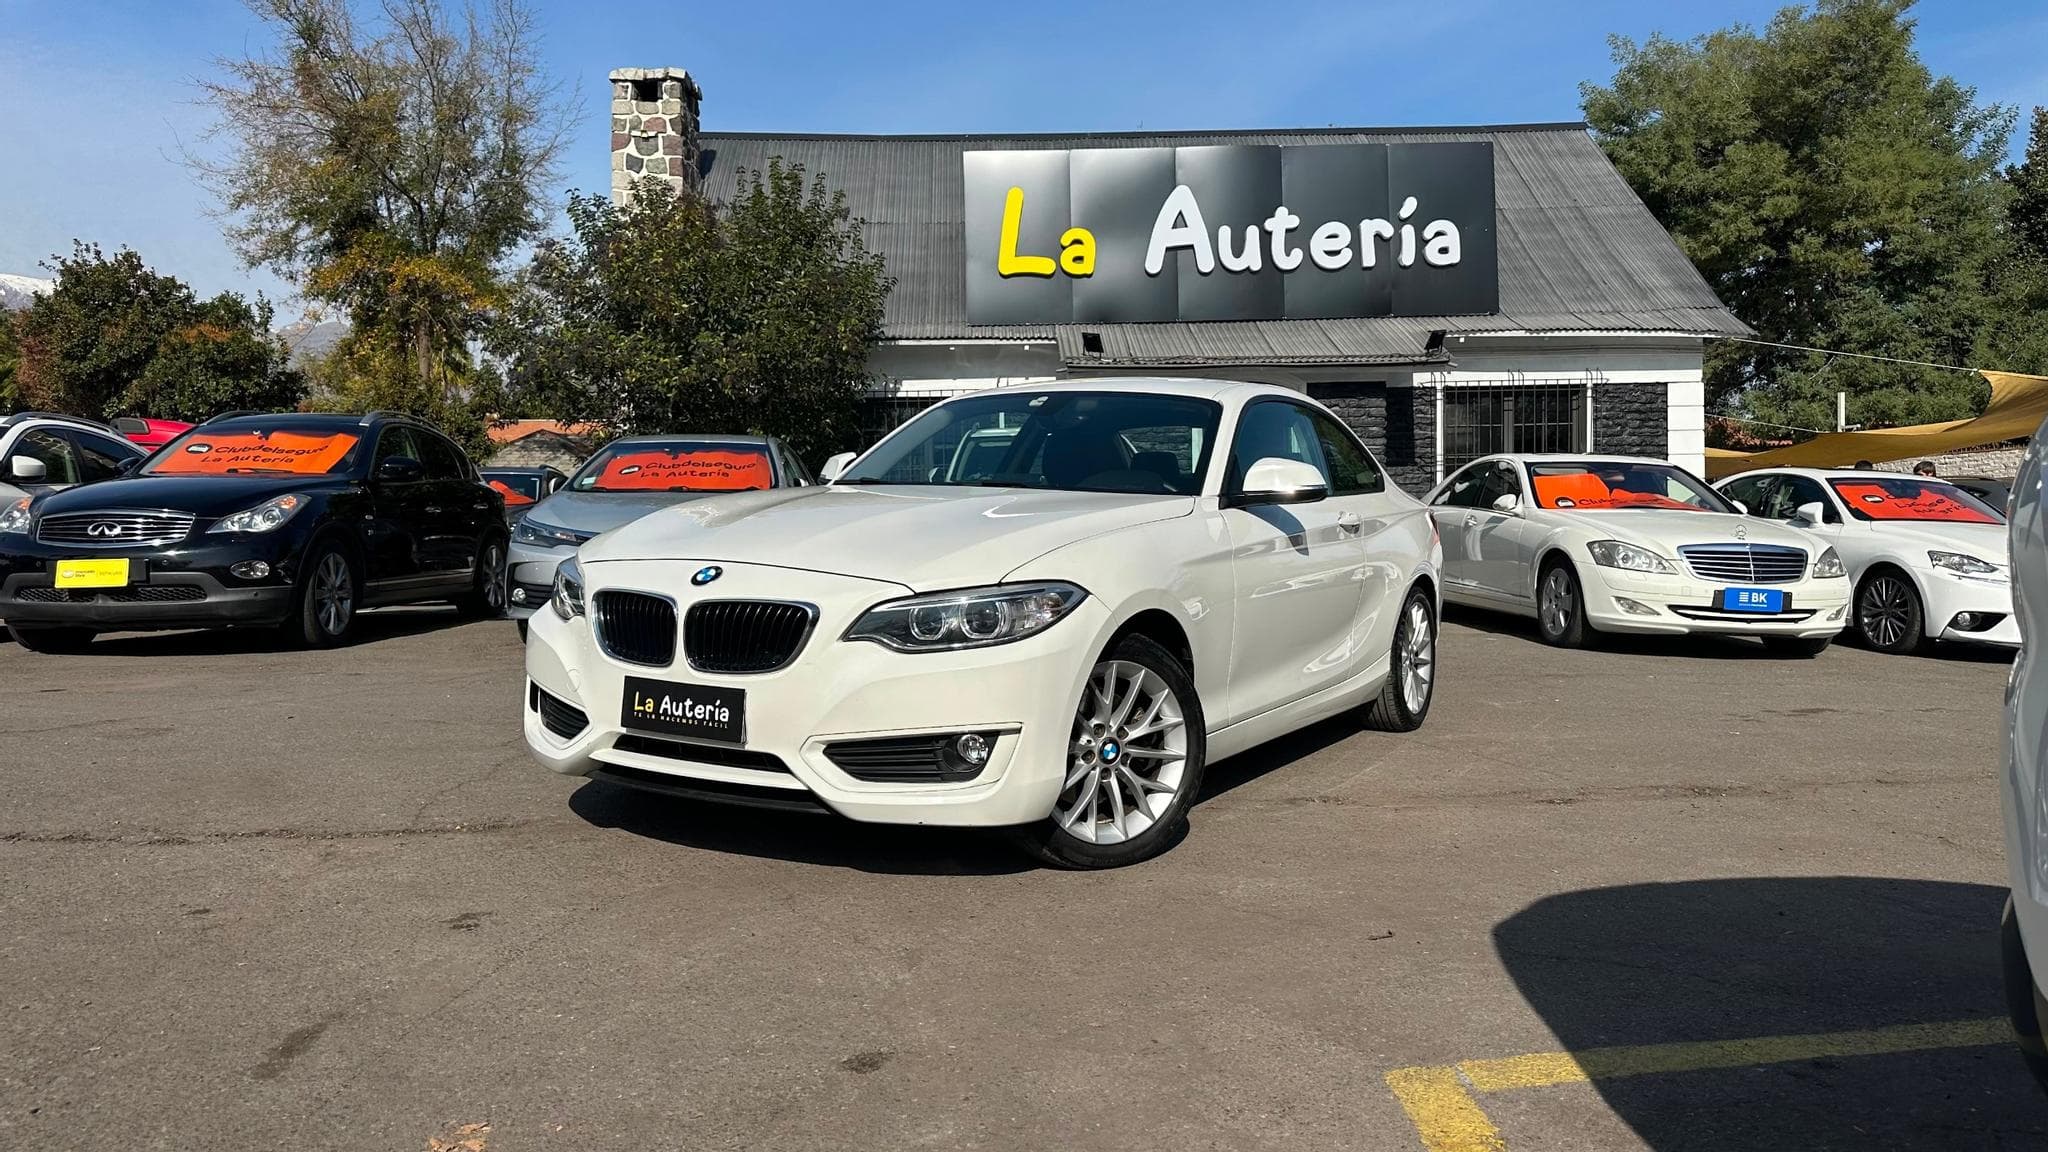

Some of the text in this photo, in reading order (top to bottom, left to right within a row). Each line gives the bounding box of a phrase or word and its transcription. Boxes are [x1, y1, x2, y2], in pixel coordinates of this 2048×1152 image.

[998, 185, 1462, 277] La Autería
[640, 471, 660, 479] La
[1751, 592, 1768, 603] BK
[634, 691, 730, 722] La Autería
